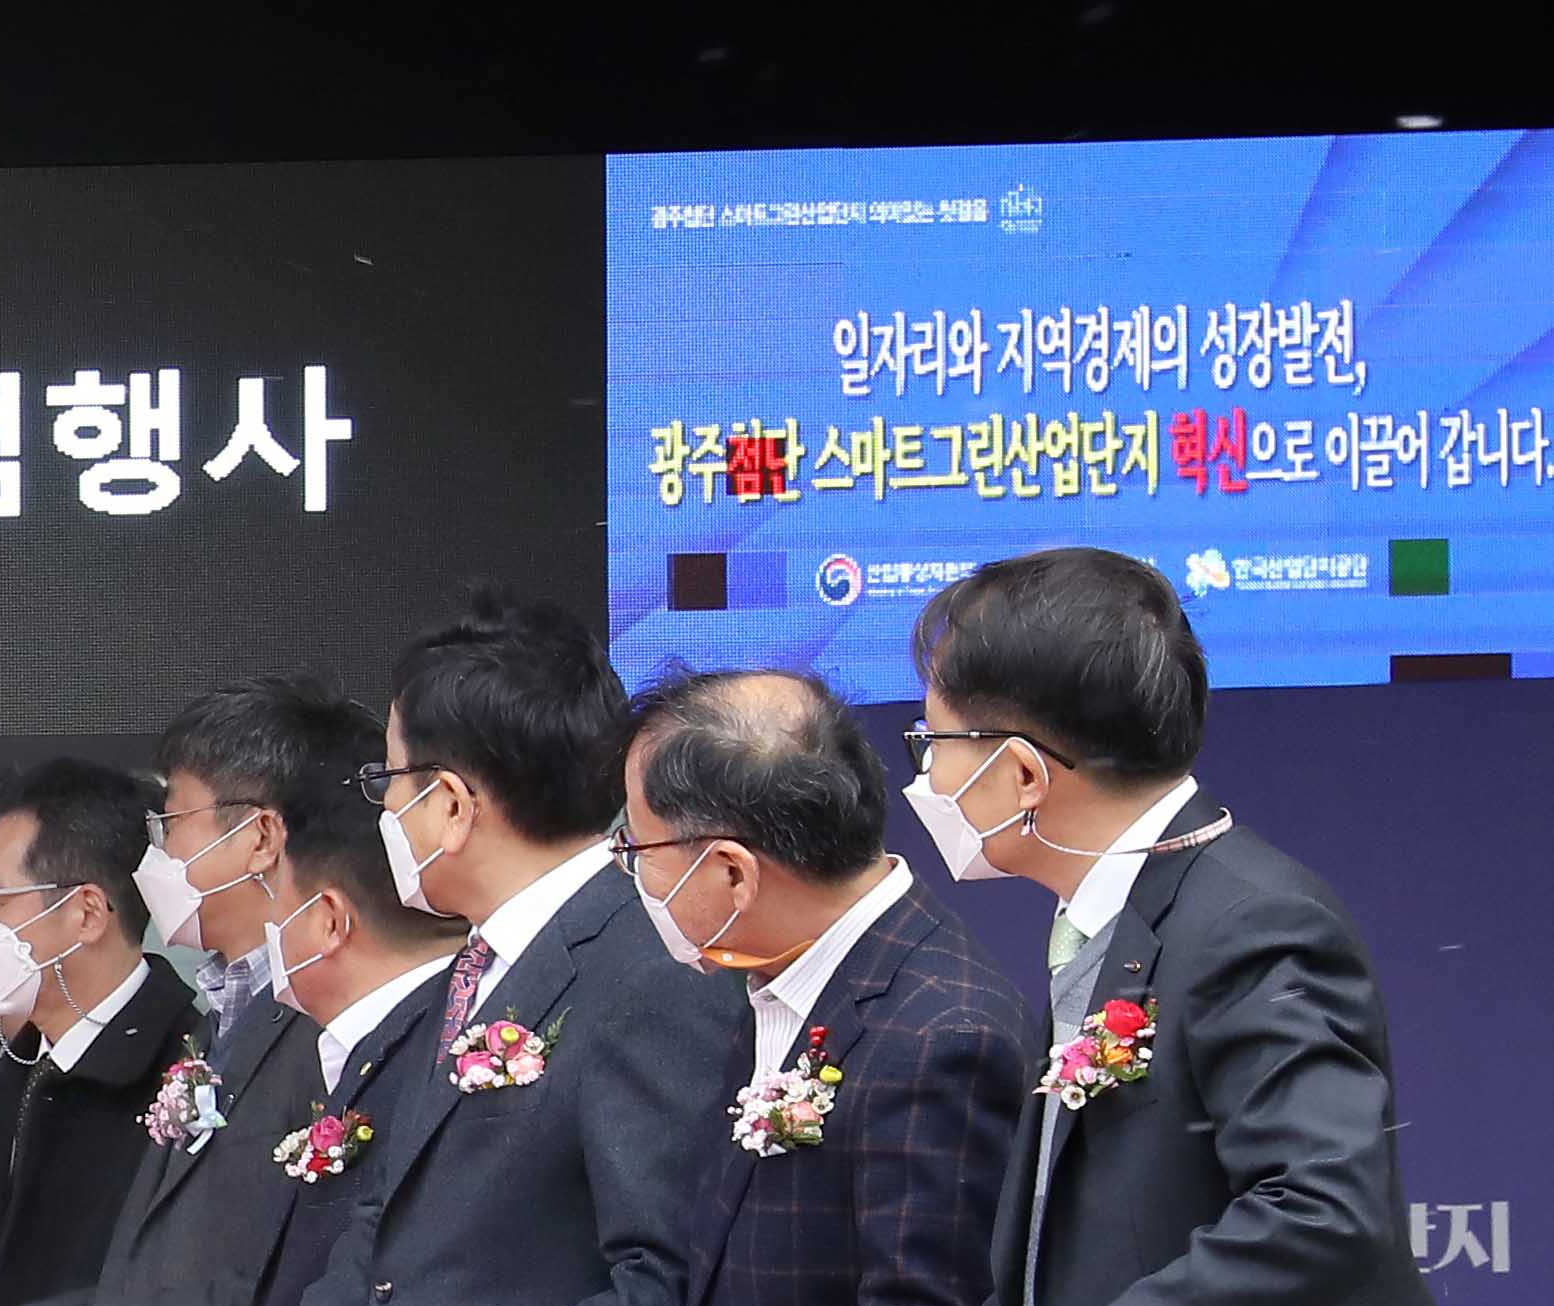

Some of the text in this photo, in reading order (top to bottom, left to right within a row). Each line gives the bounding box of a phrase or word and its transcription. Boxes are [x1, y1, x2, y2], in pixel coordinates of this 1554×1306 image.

[833, 299, 1367, 396] 일자리와 지역경제의 성장발전,
[649, 418, 805, 505] 광주첨단
[811, 409, 1159, 501] 스마트그린산업단지
[1170, 407, 1321, 496] 혁신으로
[1325, 410, 1428, 491] 이끌어
